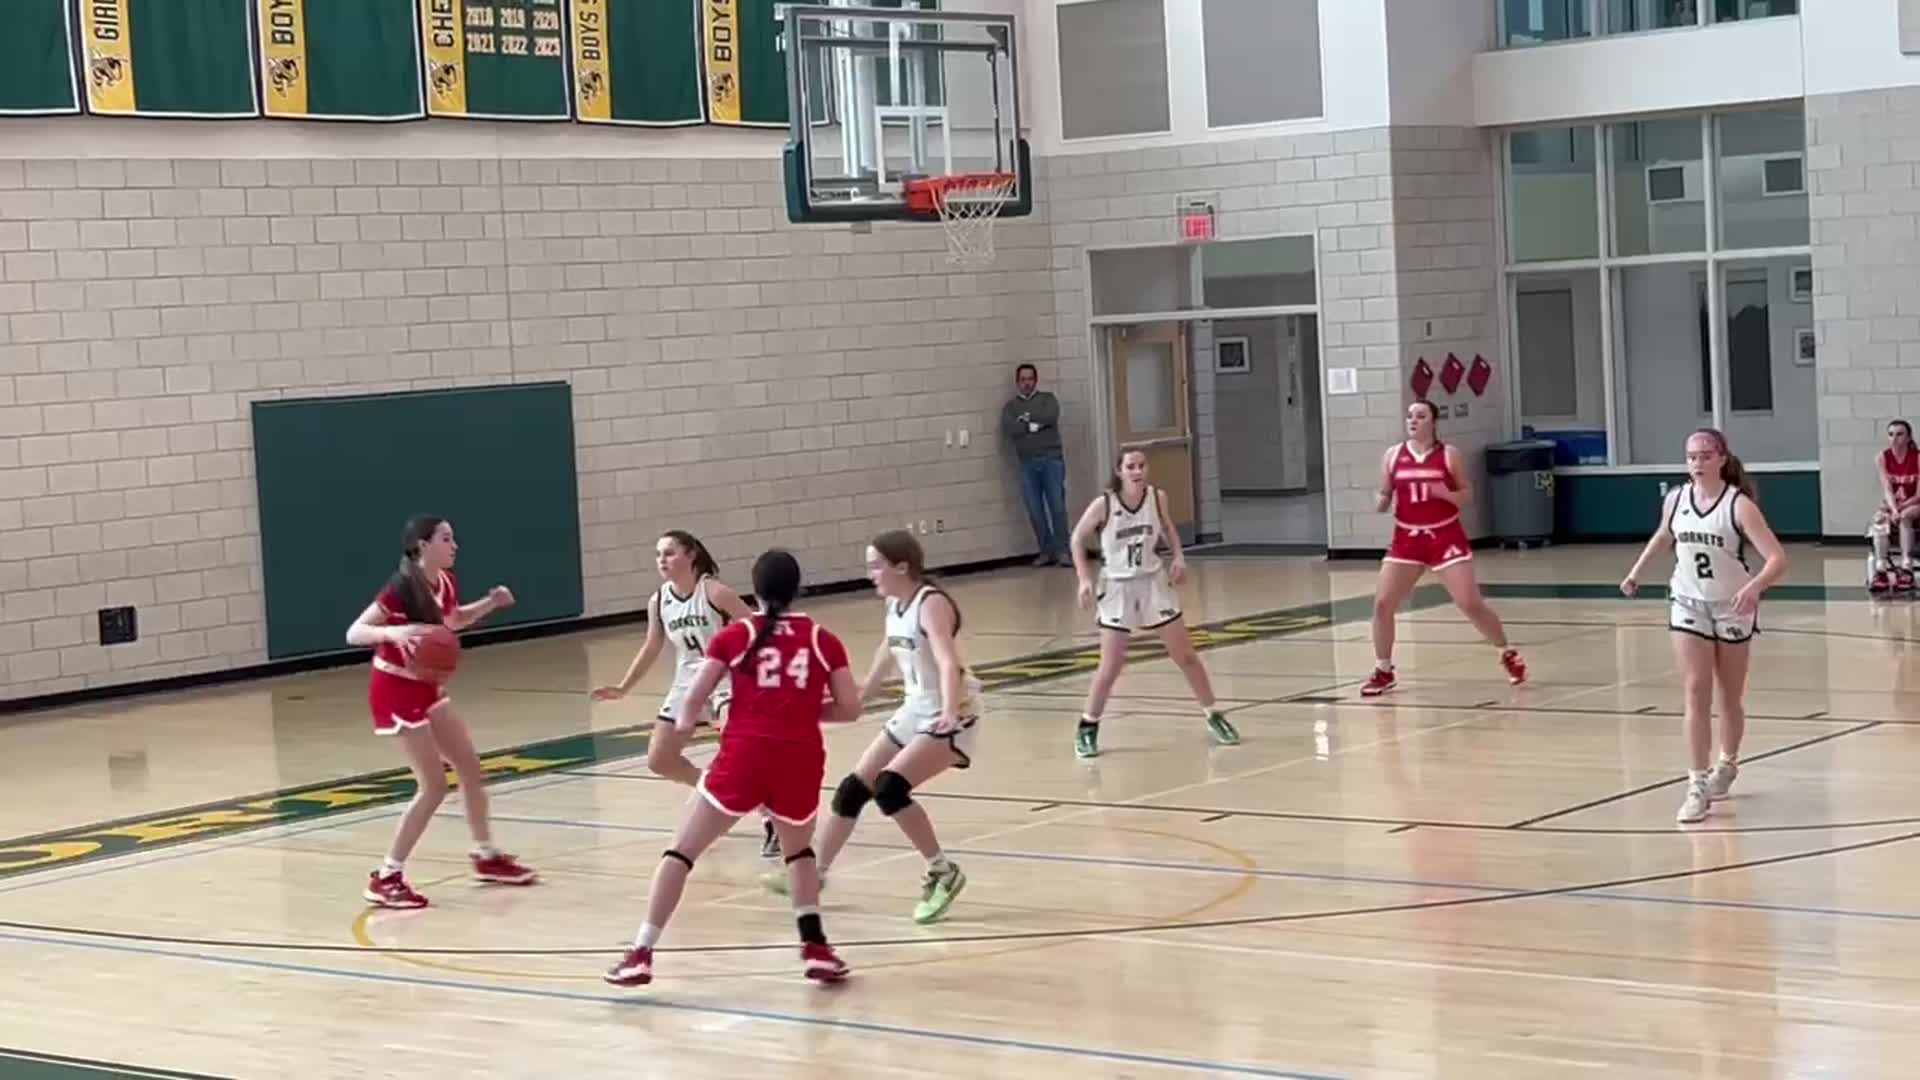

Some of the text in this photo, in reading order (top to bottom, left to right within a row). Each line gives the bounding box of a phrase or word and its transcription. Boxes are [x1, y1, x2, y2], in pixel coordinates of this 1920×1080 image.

[533, 10, 559, 30] 2020
[466, 32, 496, 53] 2021
[501, 34, 528, 55] 2022
[580, 11, 600, 60] BOYS
[1410, 482, 1428, 503] 11
[1694, 552, 1714, 579] 2
[683, 635, 705, 658] 4
[757, 647, 809, 690] 24
